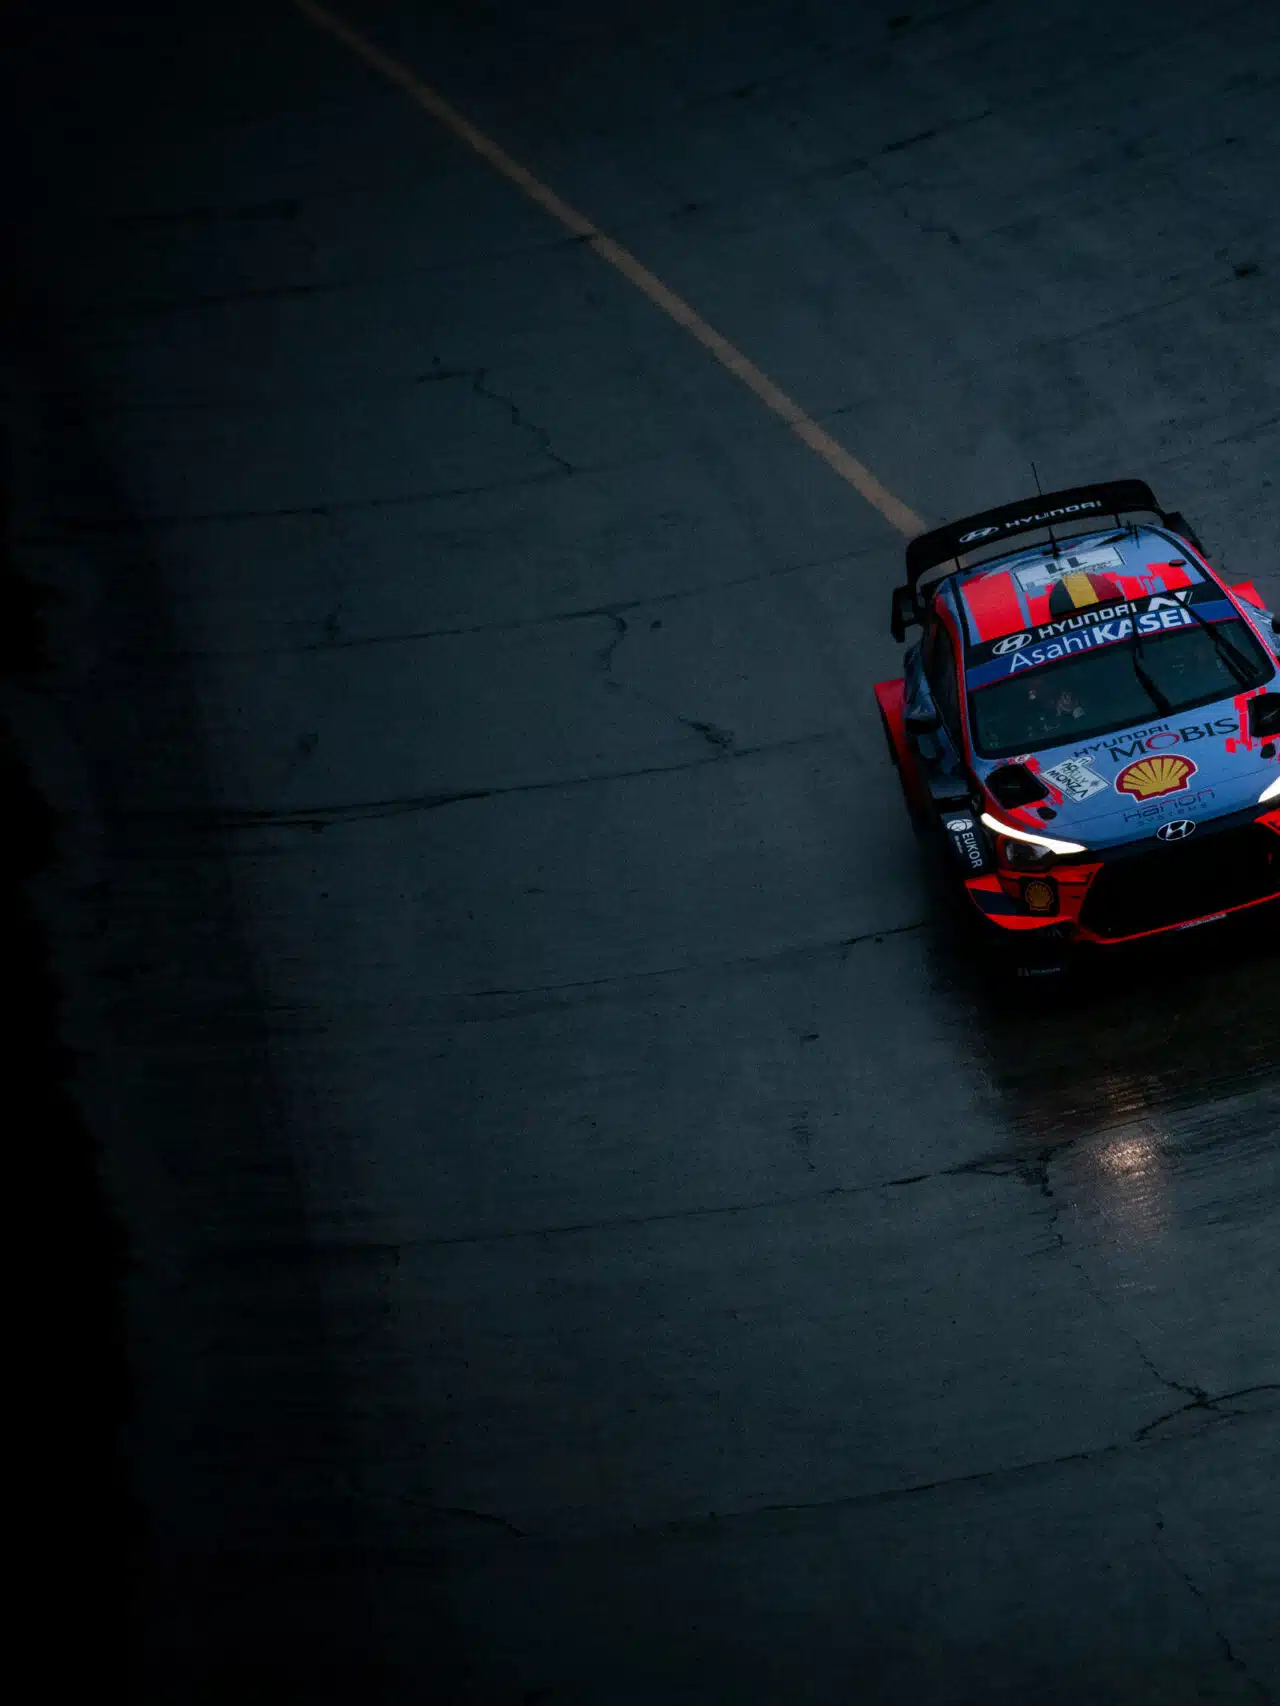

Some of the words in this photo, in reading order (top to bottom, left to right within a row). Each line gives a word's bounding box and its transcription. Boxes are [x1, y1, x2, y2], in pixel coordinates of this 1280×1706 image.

[1005, 500, 1102, 529] HYUNDAI
[1039, 602, 1137, 639] HYUNDAI
[1074, 724, 1169, 757] HYUNDAI
[1108, 717, 1239, 762] MOBIS
[1047, 770, 1089, 798] MONZA
[962, 831, 983, 869] EUKOR
